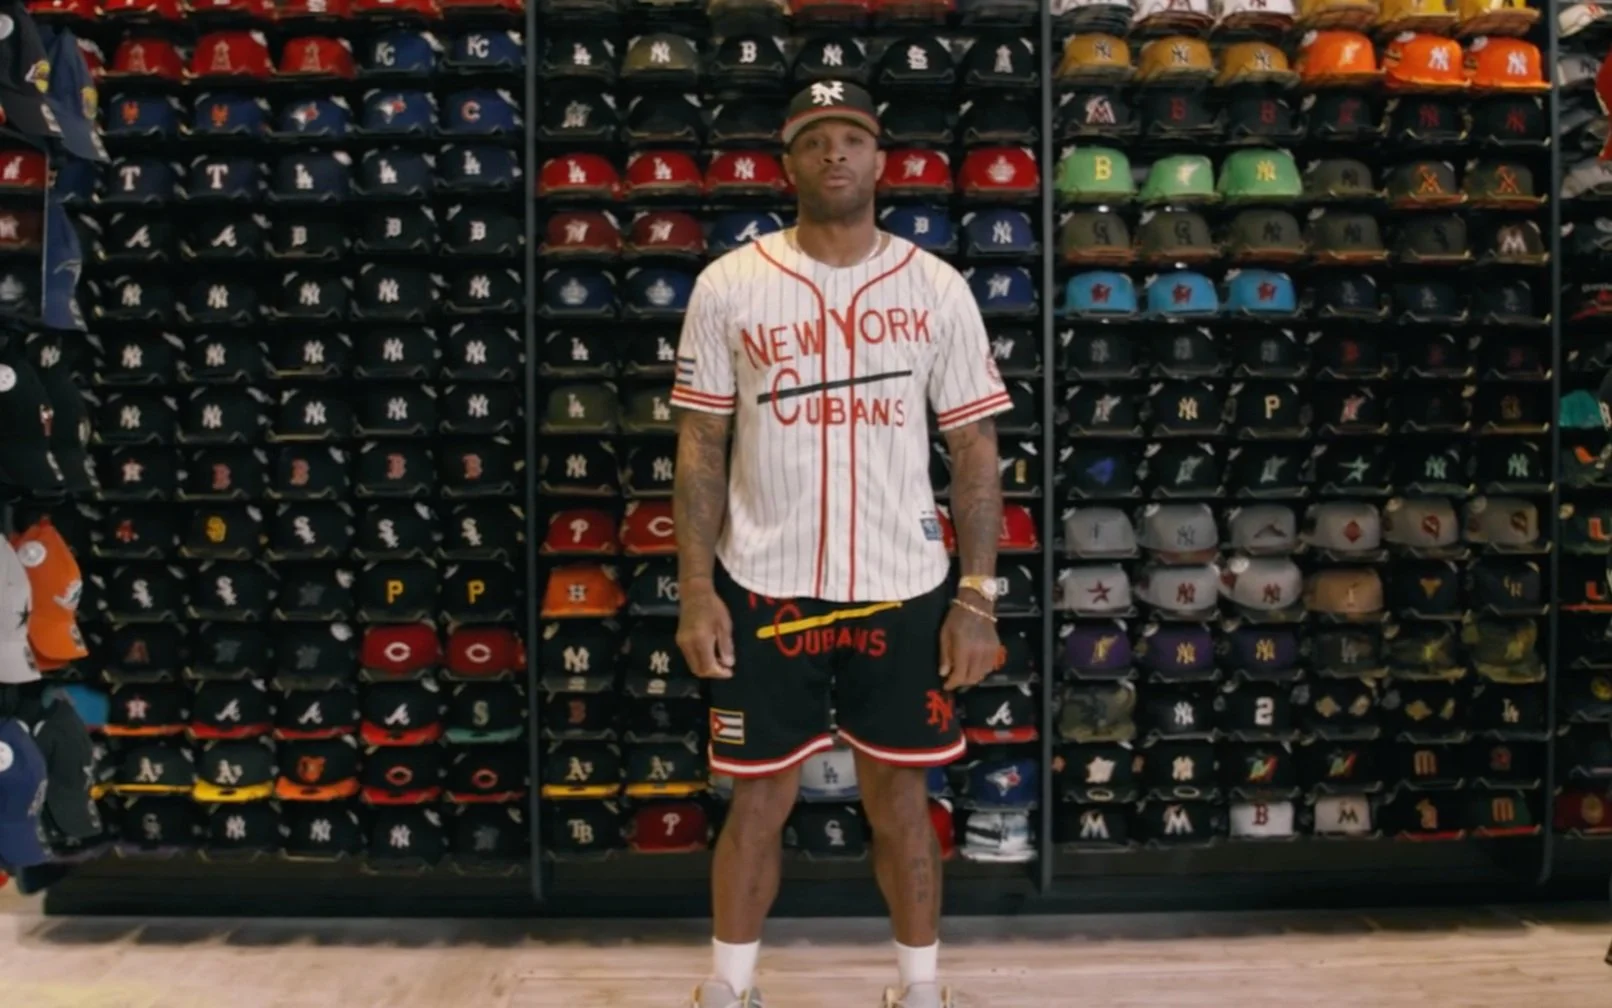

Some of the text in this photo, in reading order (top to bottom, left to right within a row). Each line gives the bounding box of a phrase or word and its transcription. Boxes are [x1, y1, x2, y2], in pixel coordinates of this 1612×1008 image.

[375, 42, 395, 66] KC
[467, 34, 489, 58] KC
[572, 42, 592, 65] LA
[651, 41, 671, 63] NY
[739, 40, 757, 63] B
[822, 43, 844, 66] NY
[1428, 46, 1449, 71] NY
[1507, 51, 1528, 75] NY
[461, 101, 481, 123] C
[379, 159, 397, 183] LA
[464, 151, 481, 175] LA
[567, 160, 587, 183] LA
[653, 157, 672, 180] LA
[734, 157, 755, 180] NY
[1094, 155, 1112, 180] B
[119, 166, 141, 191] T
[206, 164, 229, 189] T
[295, 164, 314, 189] LA
[992, 220, 1013, 244] NY
[571, 337, 589, 360] LA
[657, 337, 675, 359] LA
[741, 306, 931, 369] NEW YORK
[771, 368, 905, 426] CUBANS
[1178, 396, 1198, 420] NY
[1264, 394, 1281, 420] P
[566, 453, 588, 478] NY
[652, 456, 673, 480] NY
[1425, 455, 1447, 479] NY
[1507, 453, 1529, 478] NY
[570, 518, 590, 543] P
[647, 516, 674, 537] C
[387, 579, 404, 604] P
[467, 579, 485, 604] P
[384, 641, 411, 662] C
[465, 643, 491, 663] C
[563, 646, 590, 673] NY
[1176, 641, 1196, 664] NY
[1255, 638, 1276, 661] NY
[650, 650, 670, 674] NY
[472, 700, 489, 727] S
[1174, 701, 1194, 725] NY
[1254, 696, 1275, 725] 2
[385, 765, 413, 786] C
[662, 812, 681, 836] P
[1252, 803, 1269, 825] B
[225, 815, 246, 840] NY
[310, 818, 331, 842] NY
[389, 824, 411, 848] NY
[567, 819, 593, 844] TB
